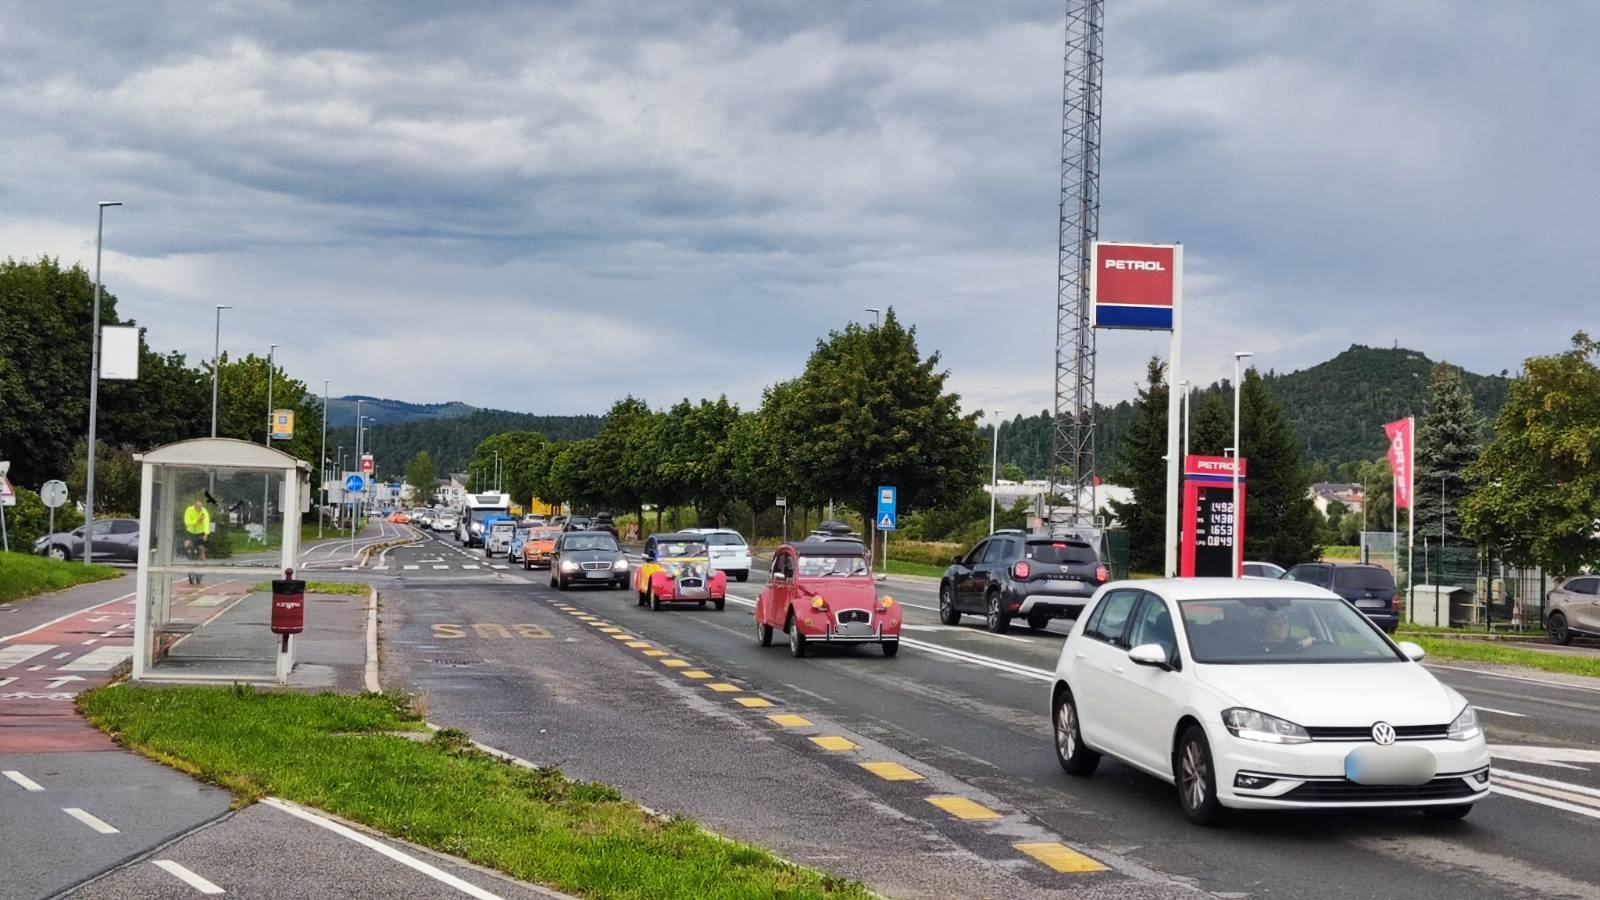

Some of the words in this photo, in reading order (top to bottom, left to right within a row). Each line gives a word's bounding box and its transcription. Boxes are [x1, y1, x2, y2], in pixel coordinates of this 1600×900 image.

[1105, 259, 1165, 271] PETROL
[1198, 461, 1240, 471] PETRO
[1212, 502, 1234, 512] 1.492
[1211, 513, 1233, 524] 1.438
[1211, 525, 1233, 535] 1.653
[1207, 536, 1233, 547] 0.849
[431, 623, 554, 639] BUS
